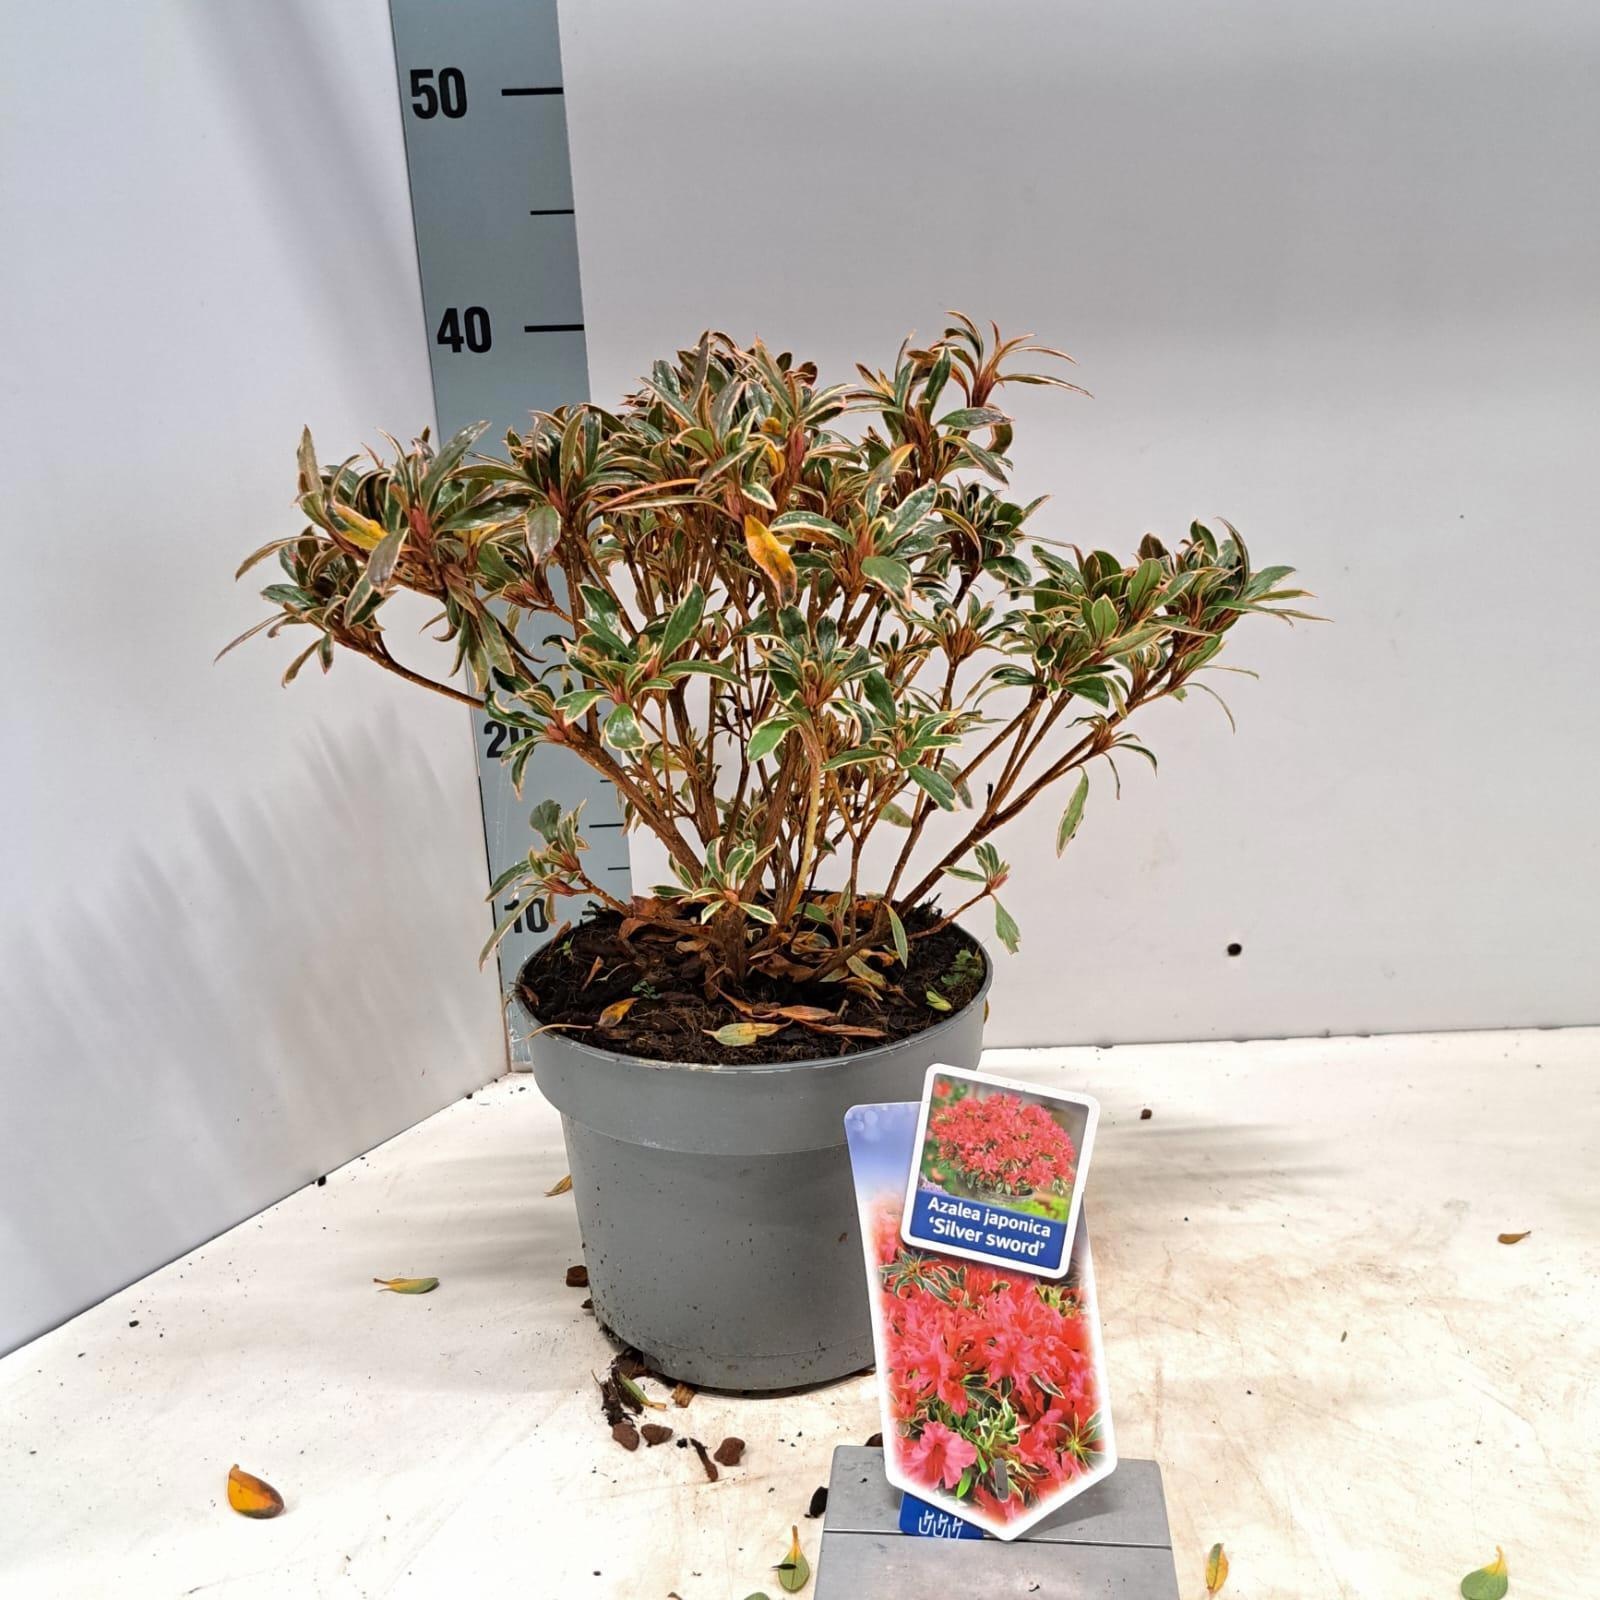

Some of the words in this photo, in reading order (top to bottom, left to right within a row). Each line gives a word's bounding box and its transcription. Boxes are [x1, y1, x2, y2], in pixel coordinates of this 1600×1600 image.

[410, 67, 467, 119] 50
[437, 306, 492, 353] 40
[927, 1196, 981, 1221] Azalea
[983, 1208, 1051, 1238] japonica
